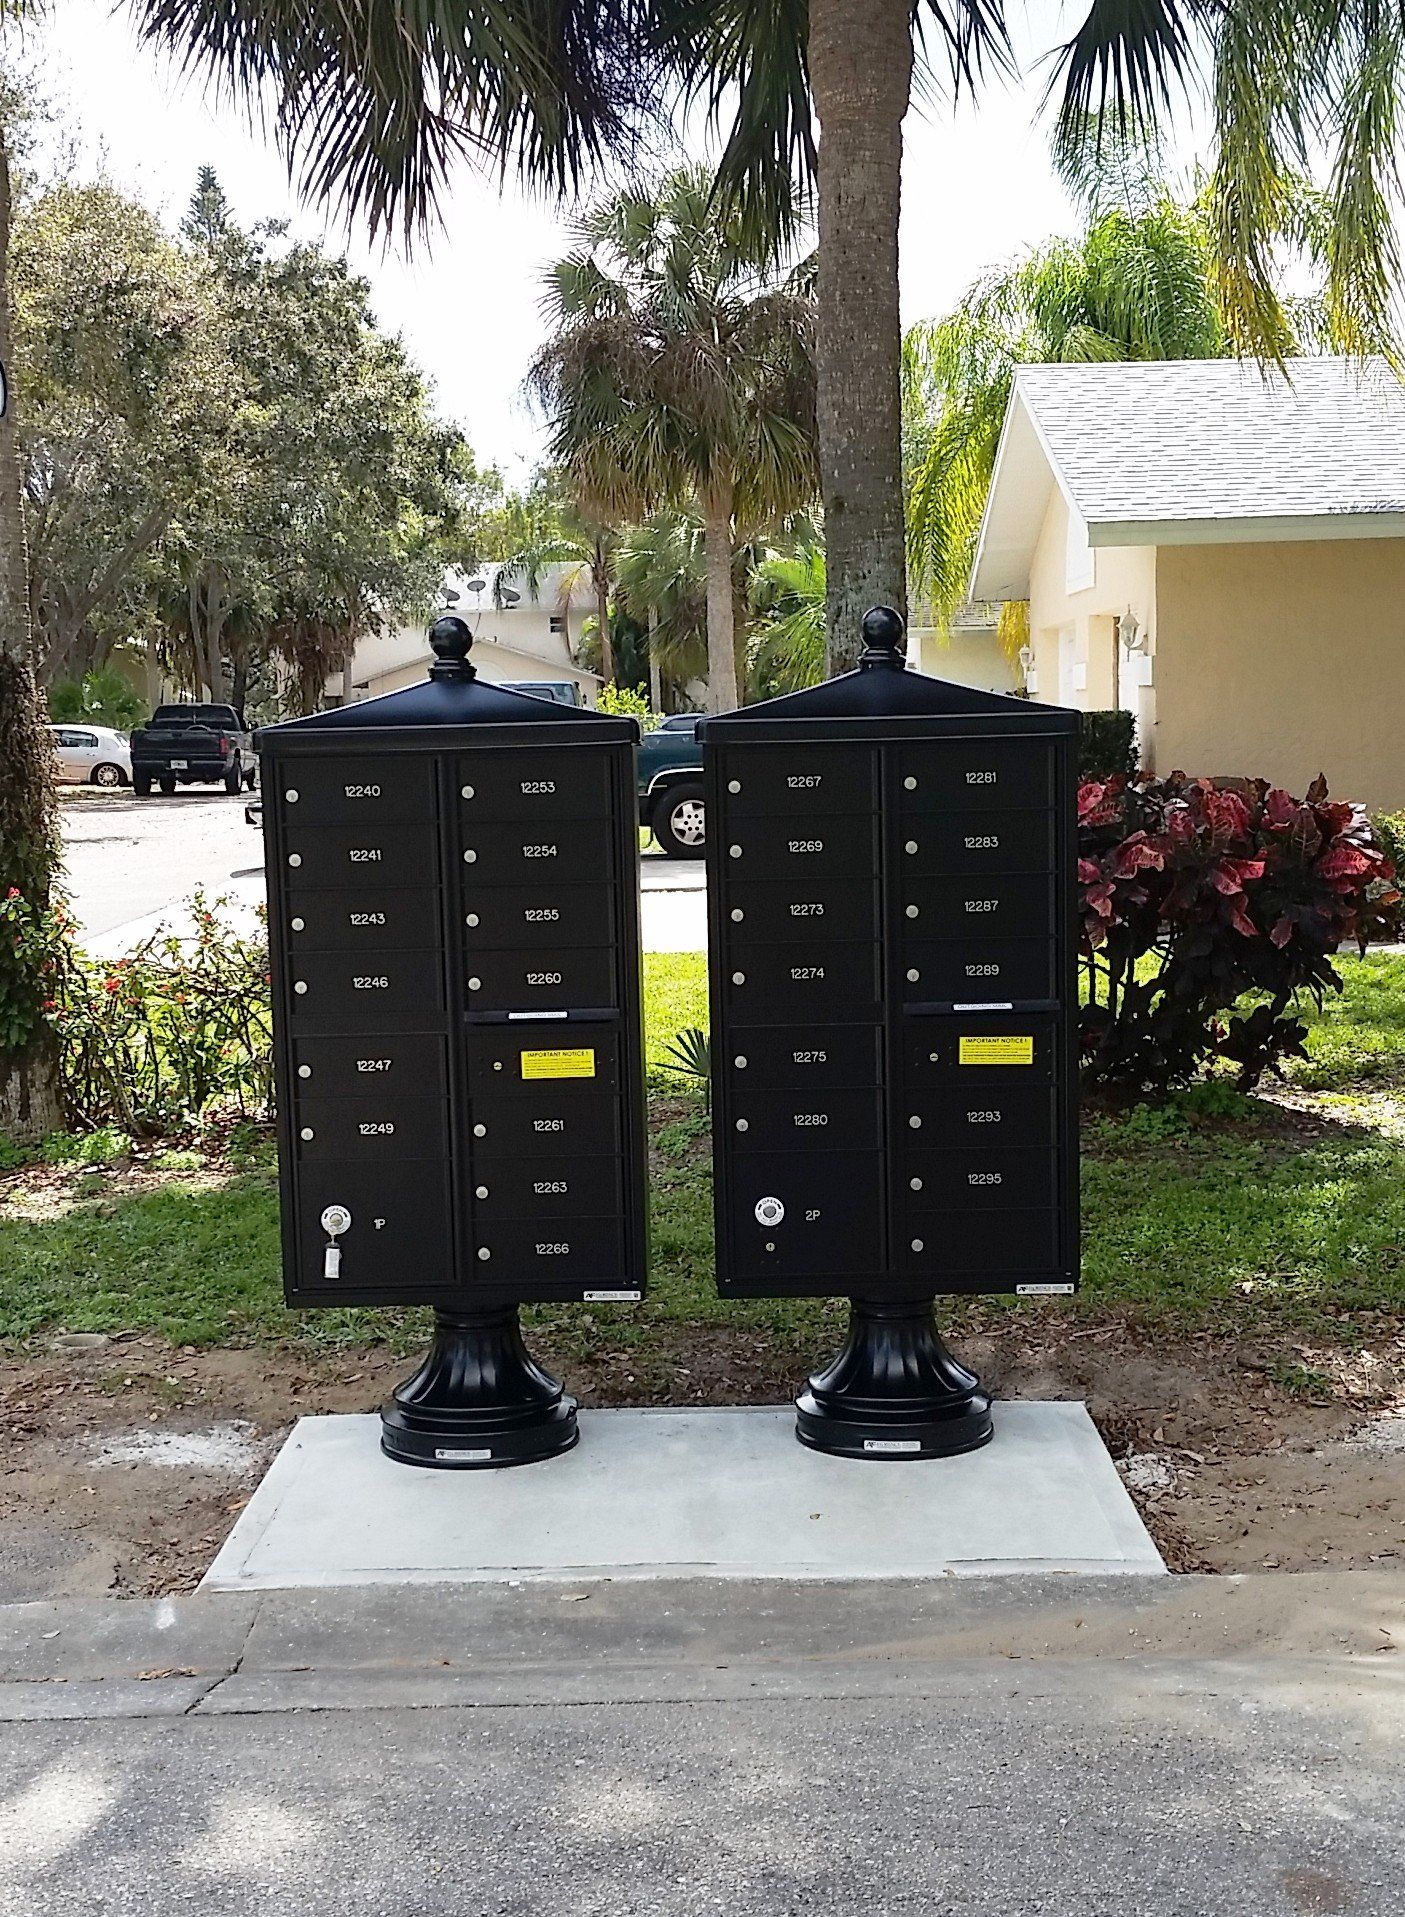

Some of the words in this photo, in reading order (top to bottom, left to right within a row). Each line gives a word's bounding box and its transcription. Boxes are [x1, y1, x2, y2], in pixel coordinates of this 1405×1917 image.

[786, 775, 822, 788] 12267
[965, 771, 997, 784] 12281
[344, 784, 381, 798] 12240
[520, 781, 556, 794] 12253
[788, 840, 823, 853] 12269
[964, 836, 999, 849] 12283
[349, 849, 382, 862] 12241
[522, 845, 558, 858] 12254
[789, 903, 824, 916] 12273
[964, 900, 999, 912] 12287
[349, 912, 386, 926] 12243
[524, 909, 560, 922] 12255
[790, 967, 825, 980] 12274
[965, 964, 1000, 976] 12289
[352, 976, 389, 989] 12246
[526, 972, 562, 985] 12260
[792, 1051, 827, 1063] 12275
[356, 1059, 392, 1072] 12247
[793, 1114, 828, 1126] 12280
[966, 1110, 1001, 1123] 12293
[358, 1122, 395, 1135] 12249
[533, 1119, 564, 1132] 12261
[967, 1173, 1002, 1185] 12295
[533, 1181, 568, 1194] 12263
[805, 1209, 821, 1221] 2P
[373, 1218, 386, 1230] 1P
[535, 1243, 570, 1255] 12266
